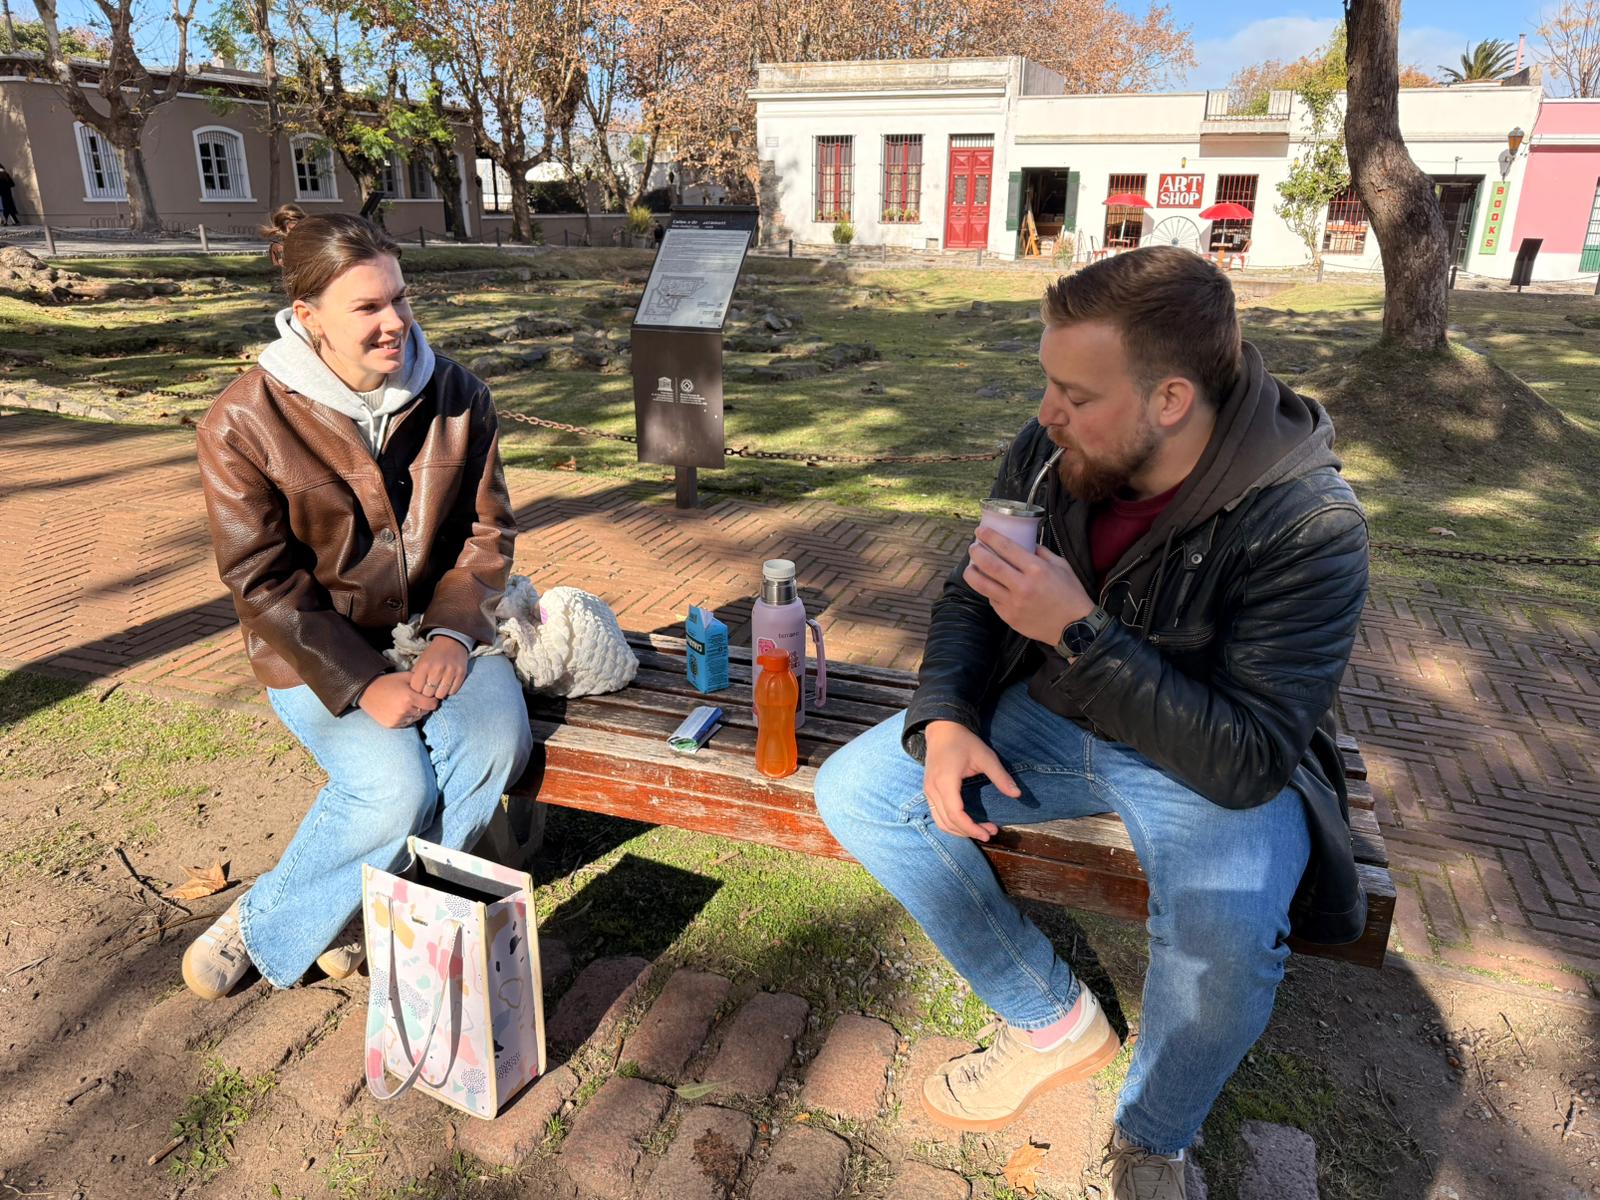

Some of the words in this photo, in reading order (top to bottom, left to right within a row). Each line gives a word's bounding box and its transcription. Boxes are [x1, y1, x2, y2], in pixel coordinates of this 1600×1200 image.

[1160, 176, 1202, 192] ART
[1159, 192, 1200, 204] SHOP
[1485, 187, 1504, 247] BOOKS
